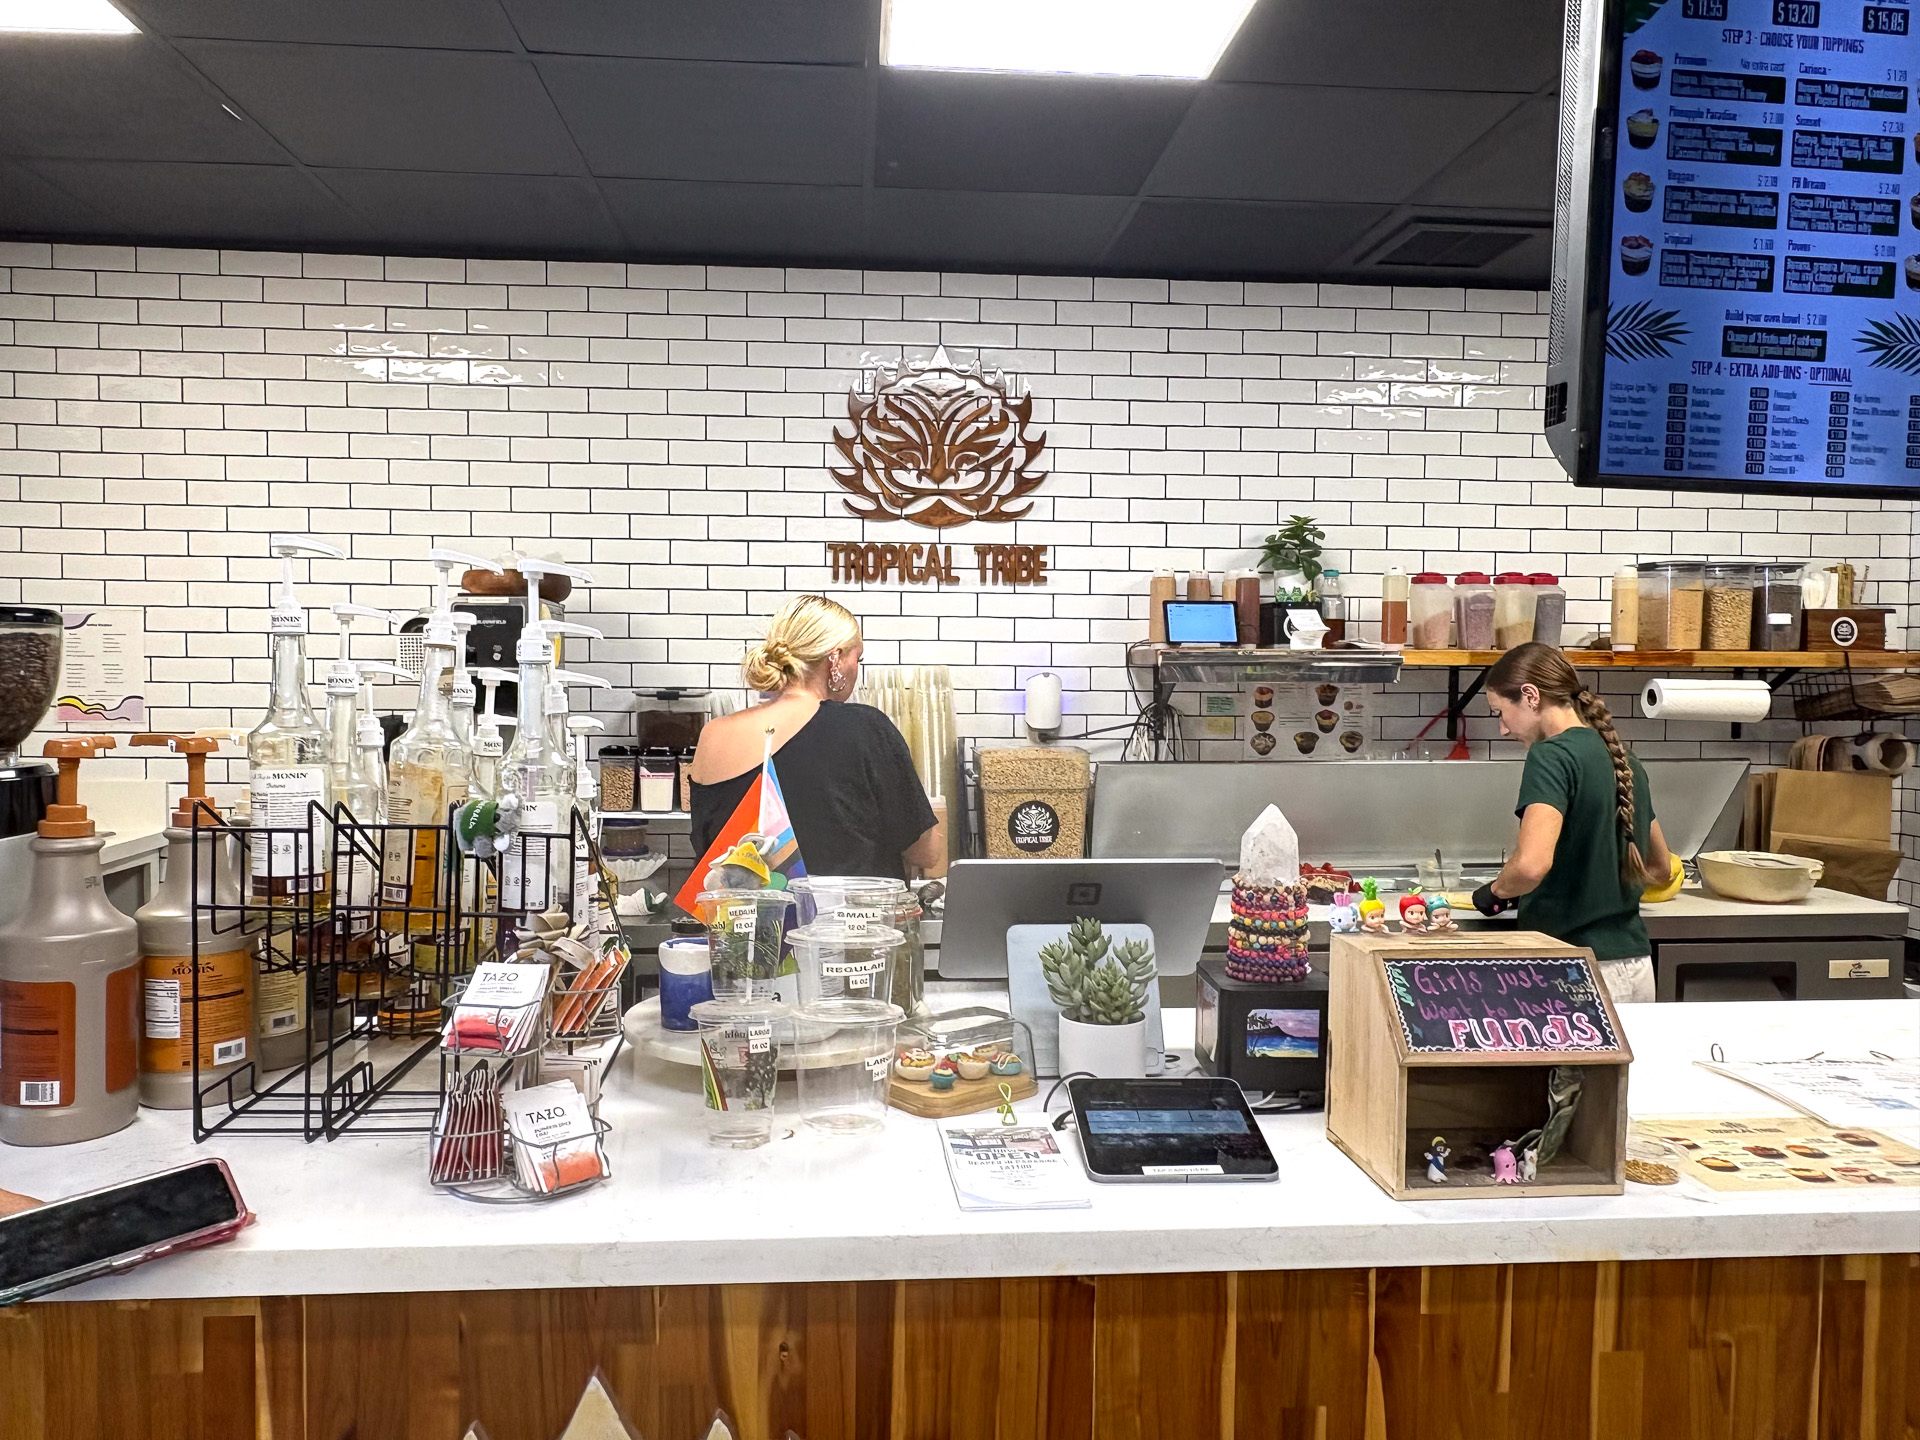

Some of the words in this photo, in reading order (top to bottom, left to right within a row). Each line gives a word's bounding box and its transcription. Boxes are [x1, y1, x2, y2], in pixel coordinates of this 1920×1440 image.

[1722, 28, 1743, 44] STEP
[1745, 30, 1752, 45] 3
[1760, 31, 1794, 49] CHOOSE
[1796, 34, 1819, 50] YOUR
[1822, 37, 1864, 54] TOPPINGS
[1691, 360, 1713, 376] STEP
[1714, 362, 1721, 376] 4
[1729, 362, 1759, 378] EXTRA
[1761, 364, 1801, 380] ADD-ONS
[1809, 367, 1852, 383] OPTIONAL
[828, 542, 960, 584] TROPICAL
[974, 544, 1047, 586] TRIBE
[272, 772, 308, 780] MONIN
[837, 911, 879, 919] SMALL
[826, 962, 884, 973] REGULAR
[483, 972, 519, 982] TAZO
[1414, 965, 1482, 995] Girls
[1493, 965, 1548, 994] just
[1417, 997, 1472, 1021] Want
[1481, 999, 1508, 1018] to
[1515, 997, 1571, 1016] have
[526, 1106, 565, 1124] TAZO
[976, 1151, 1040, 1160] OPEN
